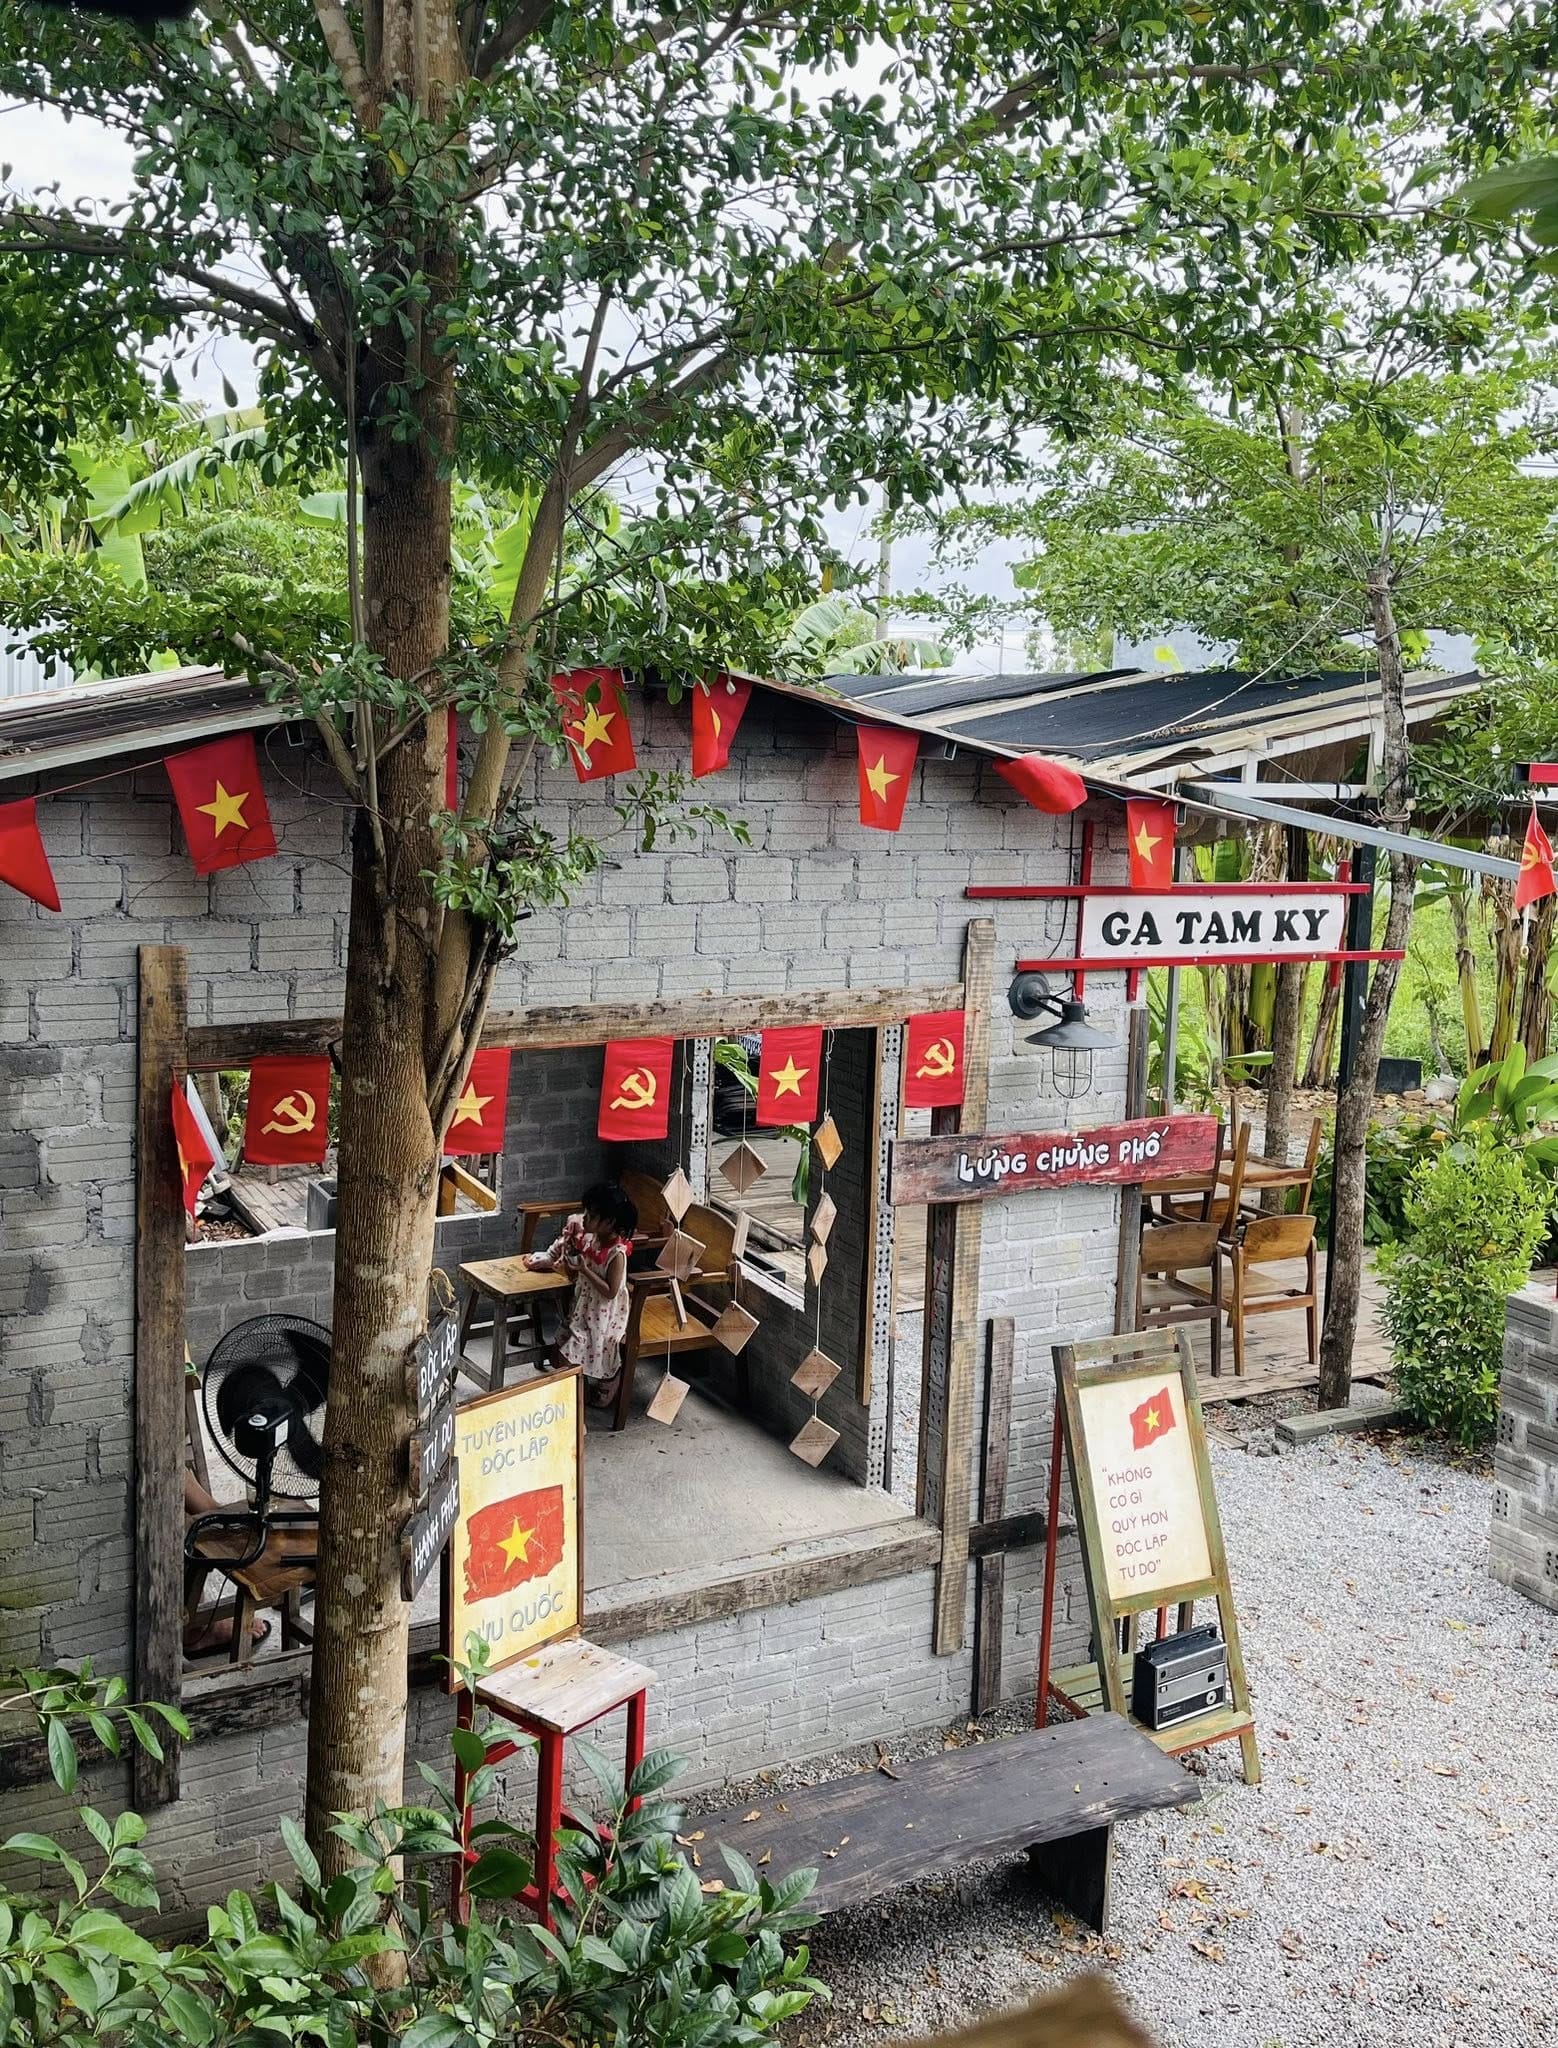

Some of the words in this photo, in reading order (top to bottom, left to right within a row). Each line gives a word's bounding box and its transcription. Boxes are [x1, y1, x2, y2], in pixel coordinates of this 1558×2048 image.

[1101, 910, 1163, 946] GA
[1176, 910, 1263, 944] TAM
[1272, 908, 1330, 942] KY
[1119, 1126, 1170, 1165] PHỐ
[462, 1420, 516, 1453] TUYÊN
[520, 1402, 565, 1434] NGÔN
[481, 1449, 515, 1476] ĐỘC
[520, 1436, 549, 1462] LẬP
[511, 1583, 563, 1632] QUỐC
